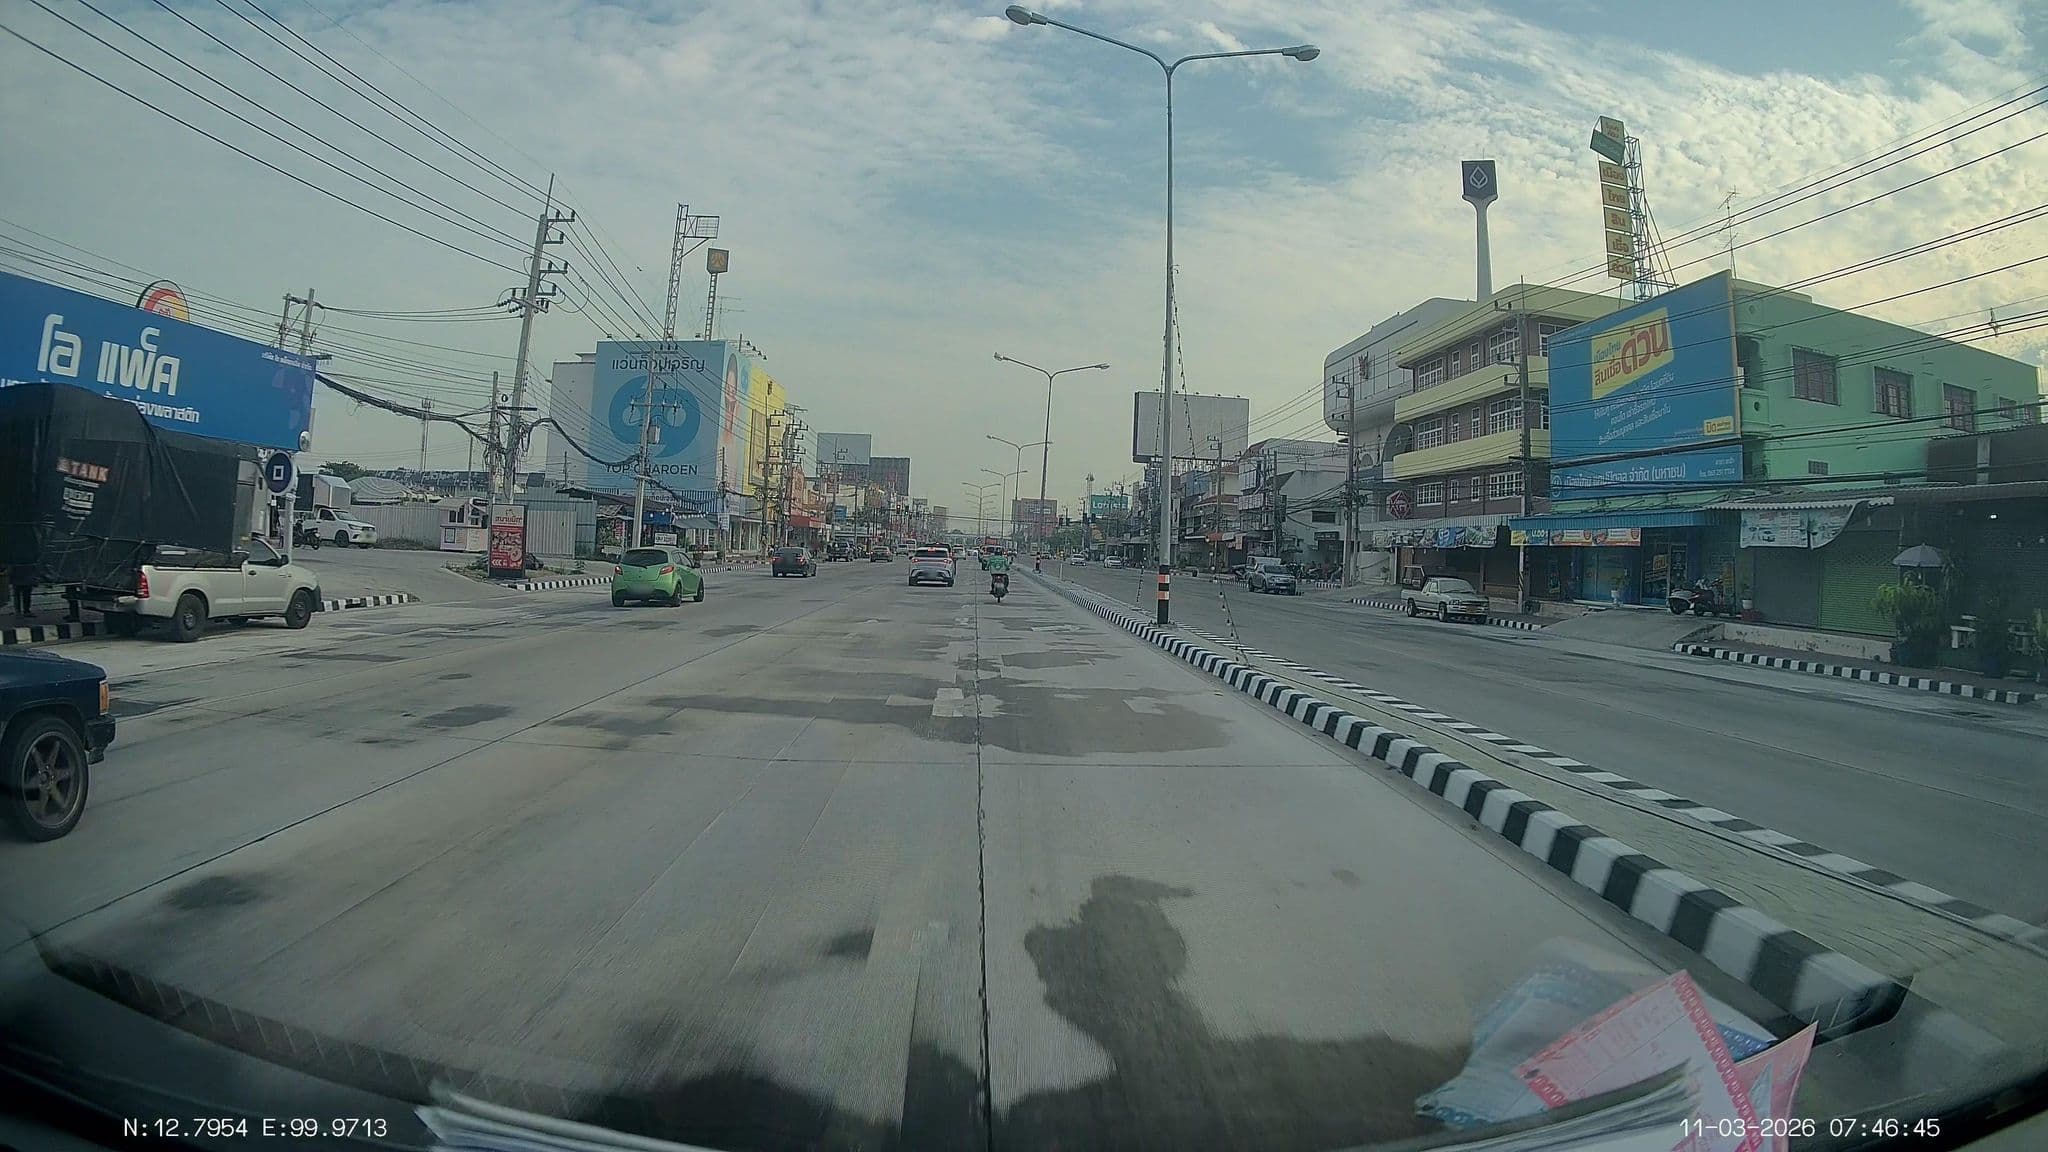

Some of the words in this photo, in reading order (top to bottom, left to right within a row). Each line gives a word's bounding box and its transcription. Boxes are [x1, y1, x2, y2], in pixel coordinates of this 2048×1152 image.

[37, 313, 82, 378] โอ
[97, 326, 180, 396] แพ็ค
[1622, 321, 1669, 375] ด่วน
[606, 464, 630, 474] TOP
[1629, 466, 1650, 482] จำกัด
[1652, 462, 1686, 481] (มหาชน)
